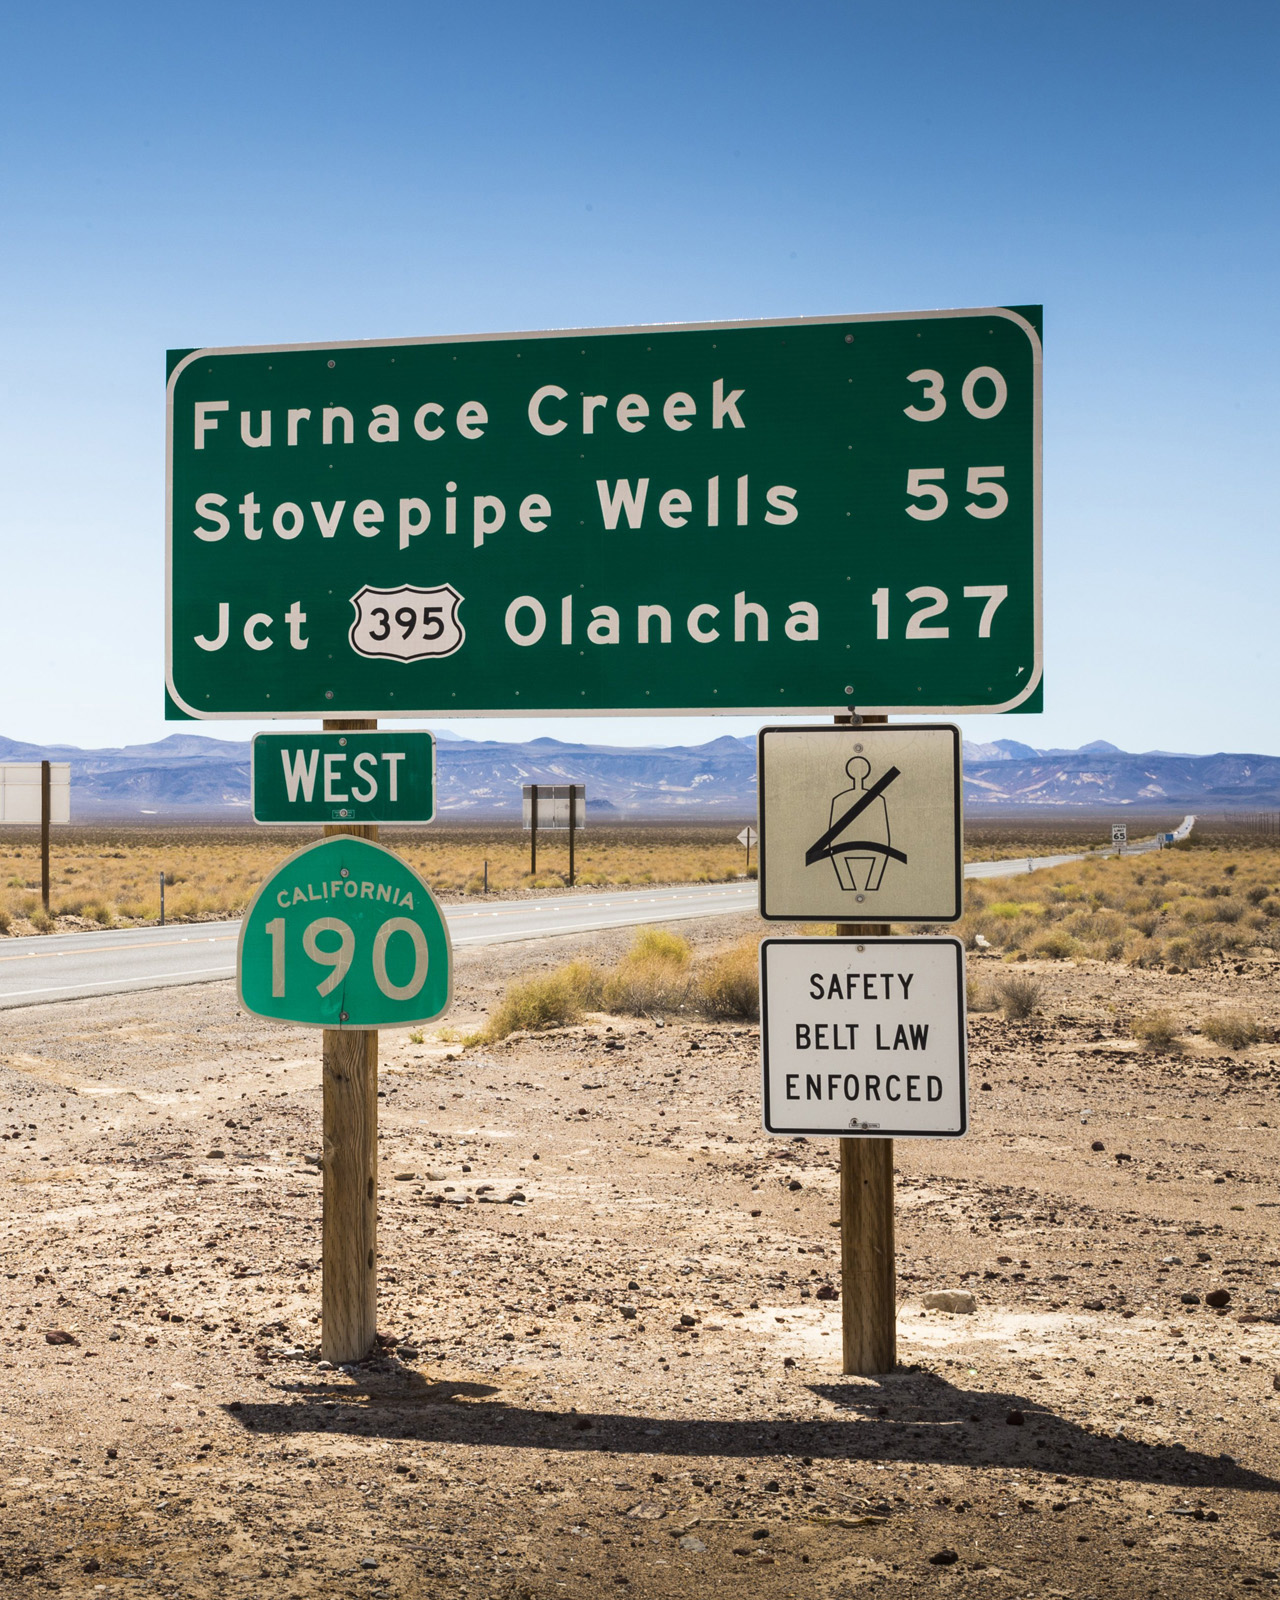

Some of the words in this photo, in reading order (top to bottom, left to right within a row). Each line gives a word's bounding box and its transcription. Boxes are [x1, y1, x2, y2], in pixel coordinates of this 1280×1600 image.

[194, 400, 489, 450] Furnace
[527, 378, 746, 436] Creek
[903, 366, 1008, 422] 30
[193, 481, 552, 551] Stovepipe
[595, 474, 799, 530] Wells
[905, 465, 1009, 522] 55
[193, 600, 309, 652] Jct
[369, 606, 445, 641] 395
[504, 590, 819, 647] Olancha
[871, 584, 1008, 640] 127
[280, 749, 406, 803] WEST
[1113, 832, 1126, 840] 65
[277, 880, 414, 911] CALIFORNIA
[265, 916, 429, 1001] 190
[809, 973, 914, 1000] SAFETY
[795, 1023, 859, 1051] BELT
[876, 1023, 929, 1051] LAW
[786, 1073, 943, 1102] ENFORCED
